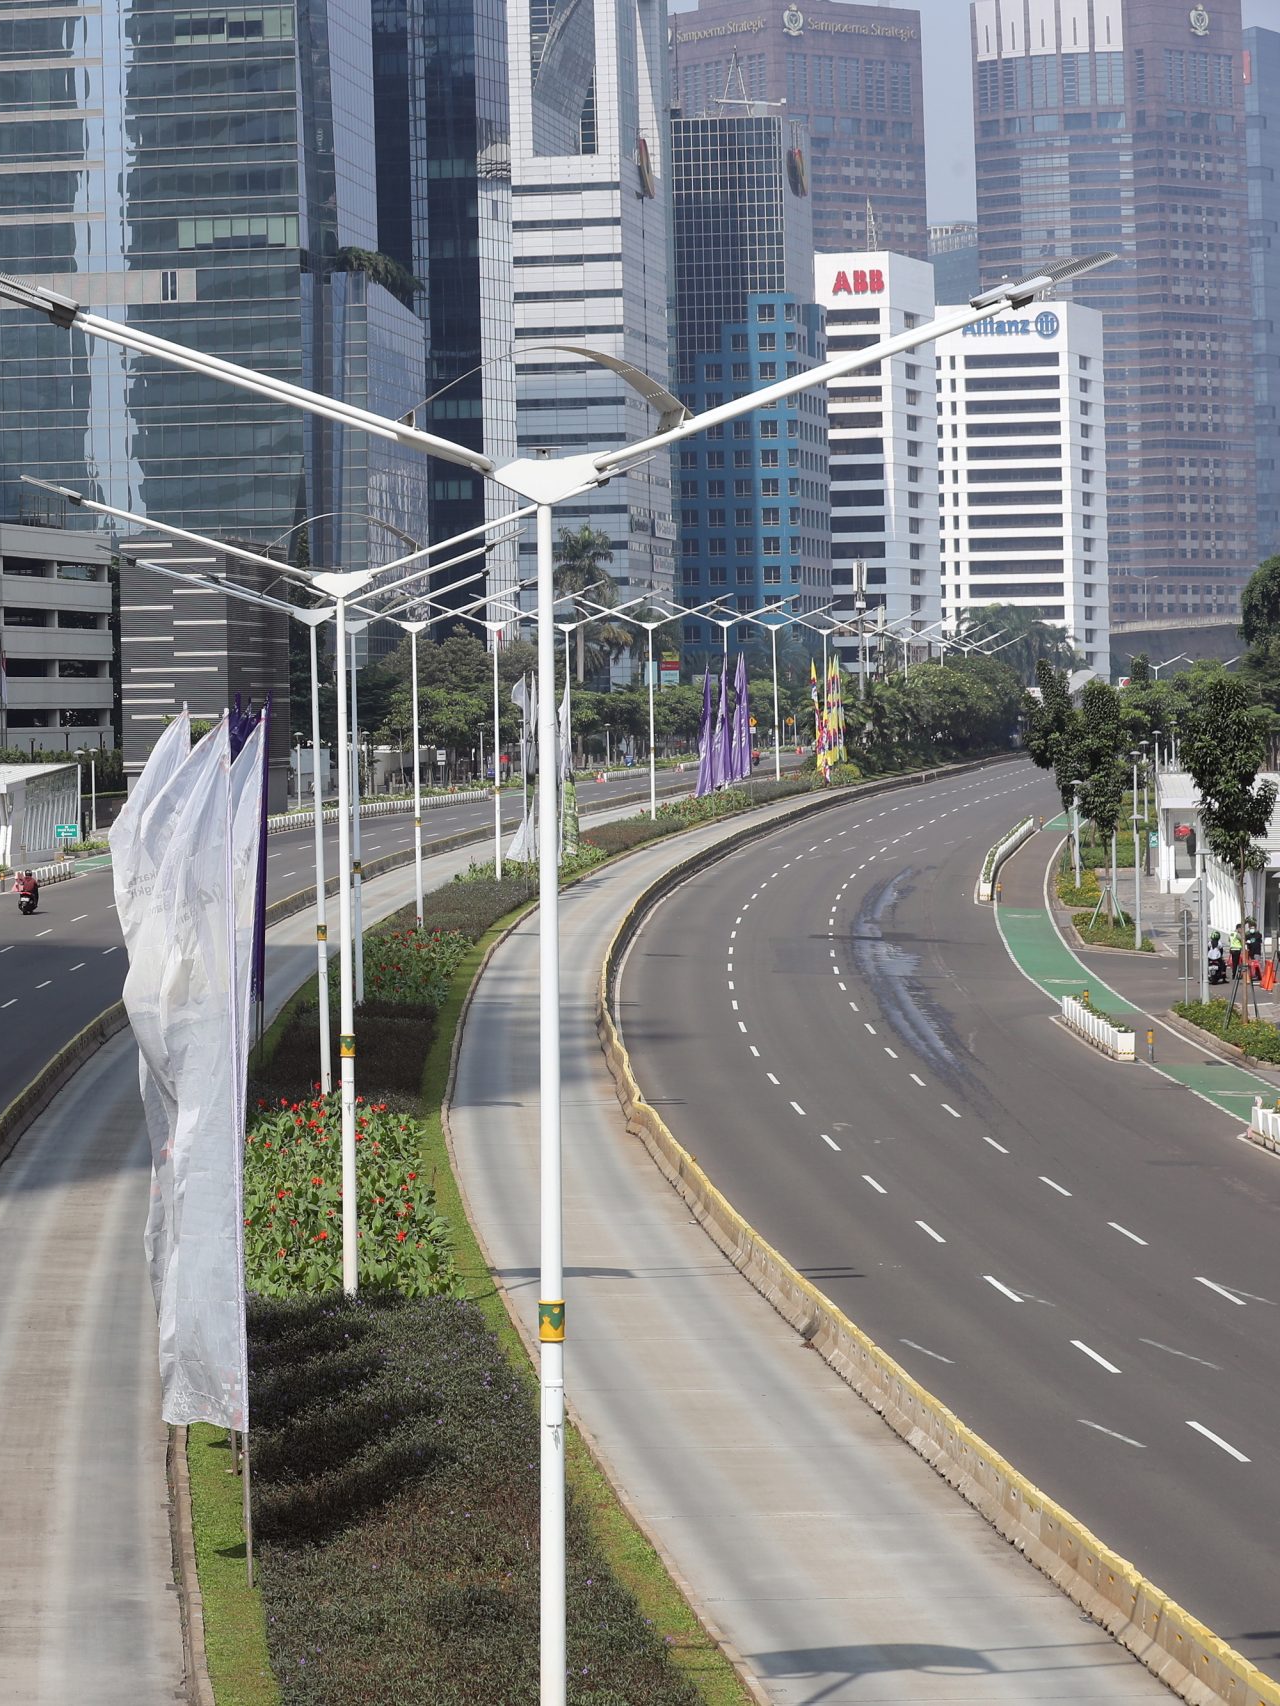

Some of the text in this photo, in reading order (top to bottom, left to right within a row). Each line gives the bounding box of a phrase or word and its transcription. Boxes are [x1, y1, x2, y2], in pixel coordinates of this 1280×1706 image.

[676, 17, 767, 43] Sampoerna Strategic
[807, 17, 918, 42] Sampoerna Strategic
[832, 269, 885, 295] ABB
[961, 315, 1031, 336] Allianz
